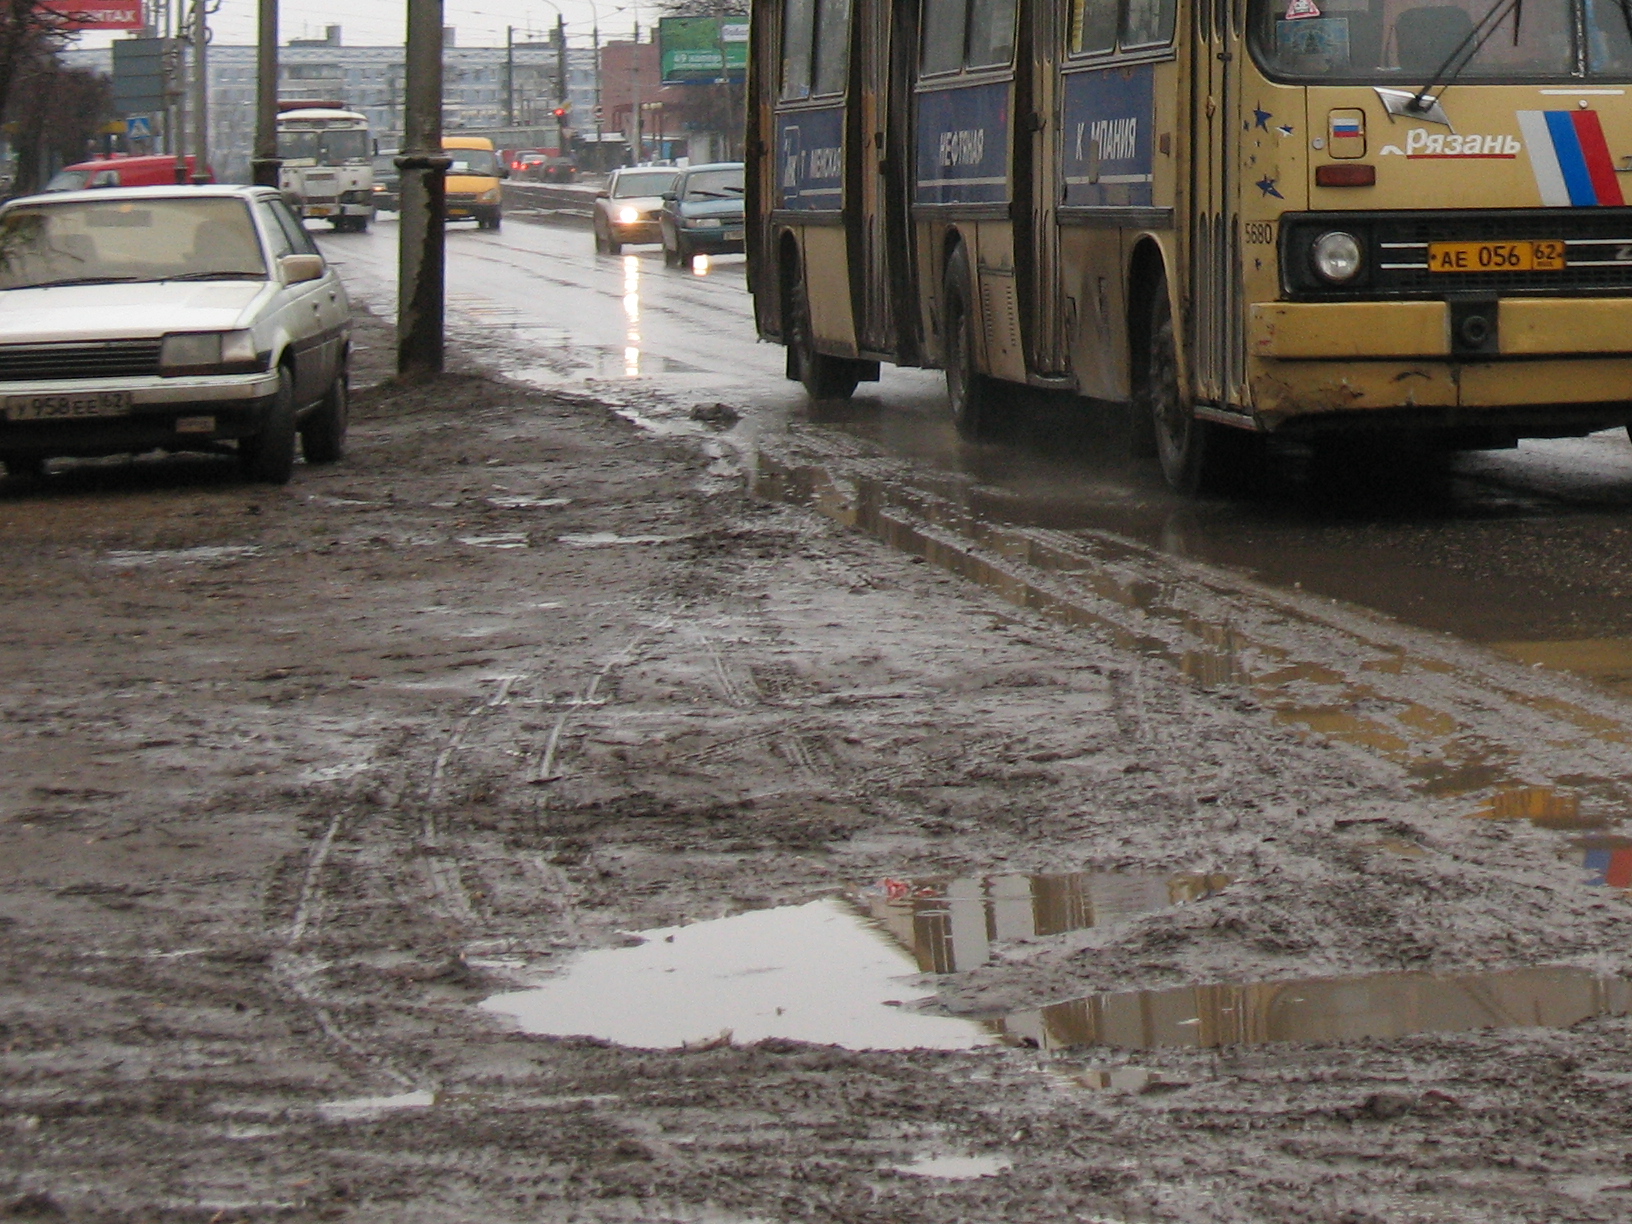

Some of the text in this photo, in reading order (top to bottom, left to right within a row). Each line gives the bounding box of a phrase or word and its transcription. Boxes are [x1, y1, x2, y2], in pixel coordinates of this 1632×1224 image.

[1245, 223, 1272, 244] 5680
[1477, 246, 1520, 267] 056
[1534, 244, 1556, 261] 62
